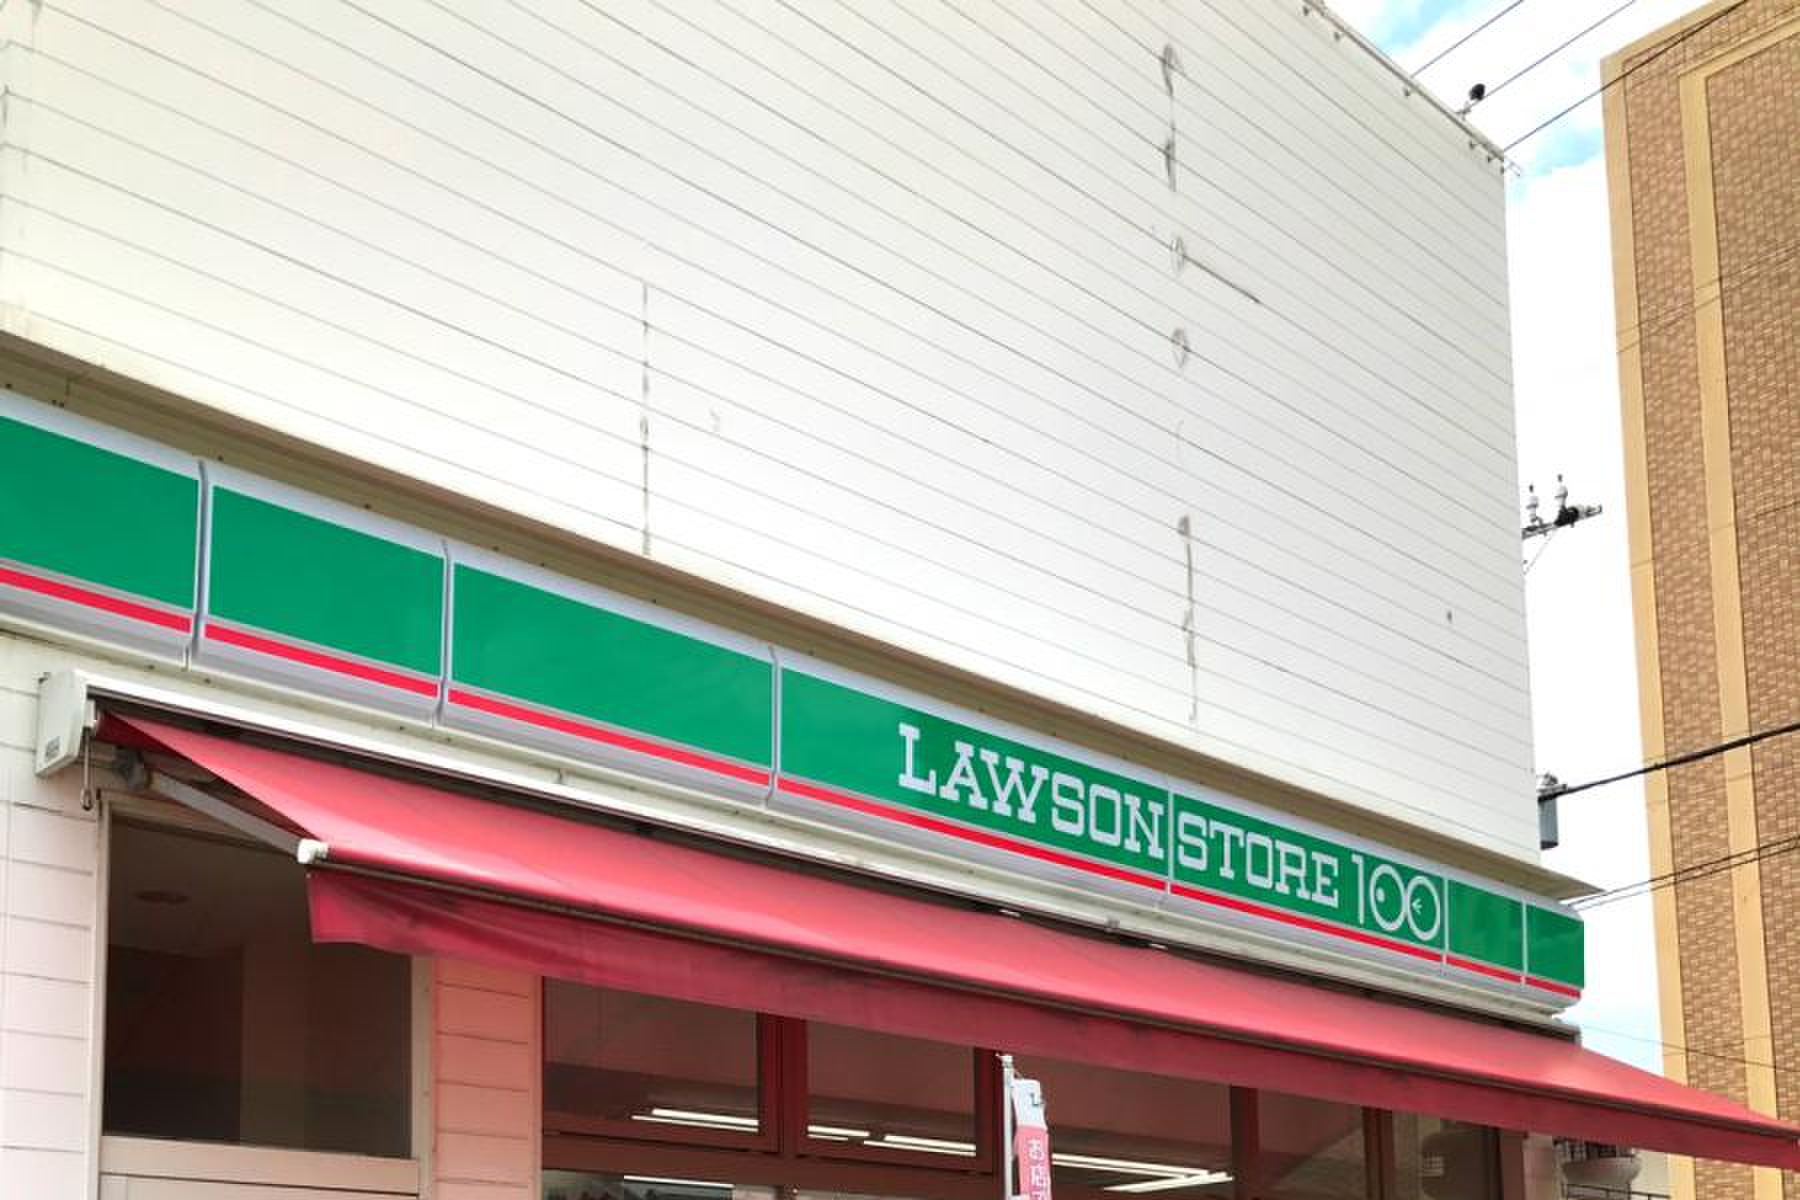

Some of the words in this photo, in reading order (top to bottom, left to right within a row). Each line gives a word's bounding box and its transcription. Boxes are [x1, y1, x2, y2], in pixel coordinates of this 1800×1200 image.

[898, 723, 1165, 858] LAWSON
[1176, 813, 1340, 907] STORE
[1350, 853, 1441, 941] 100
